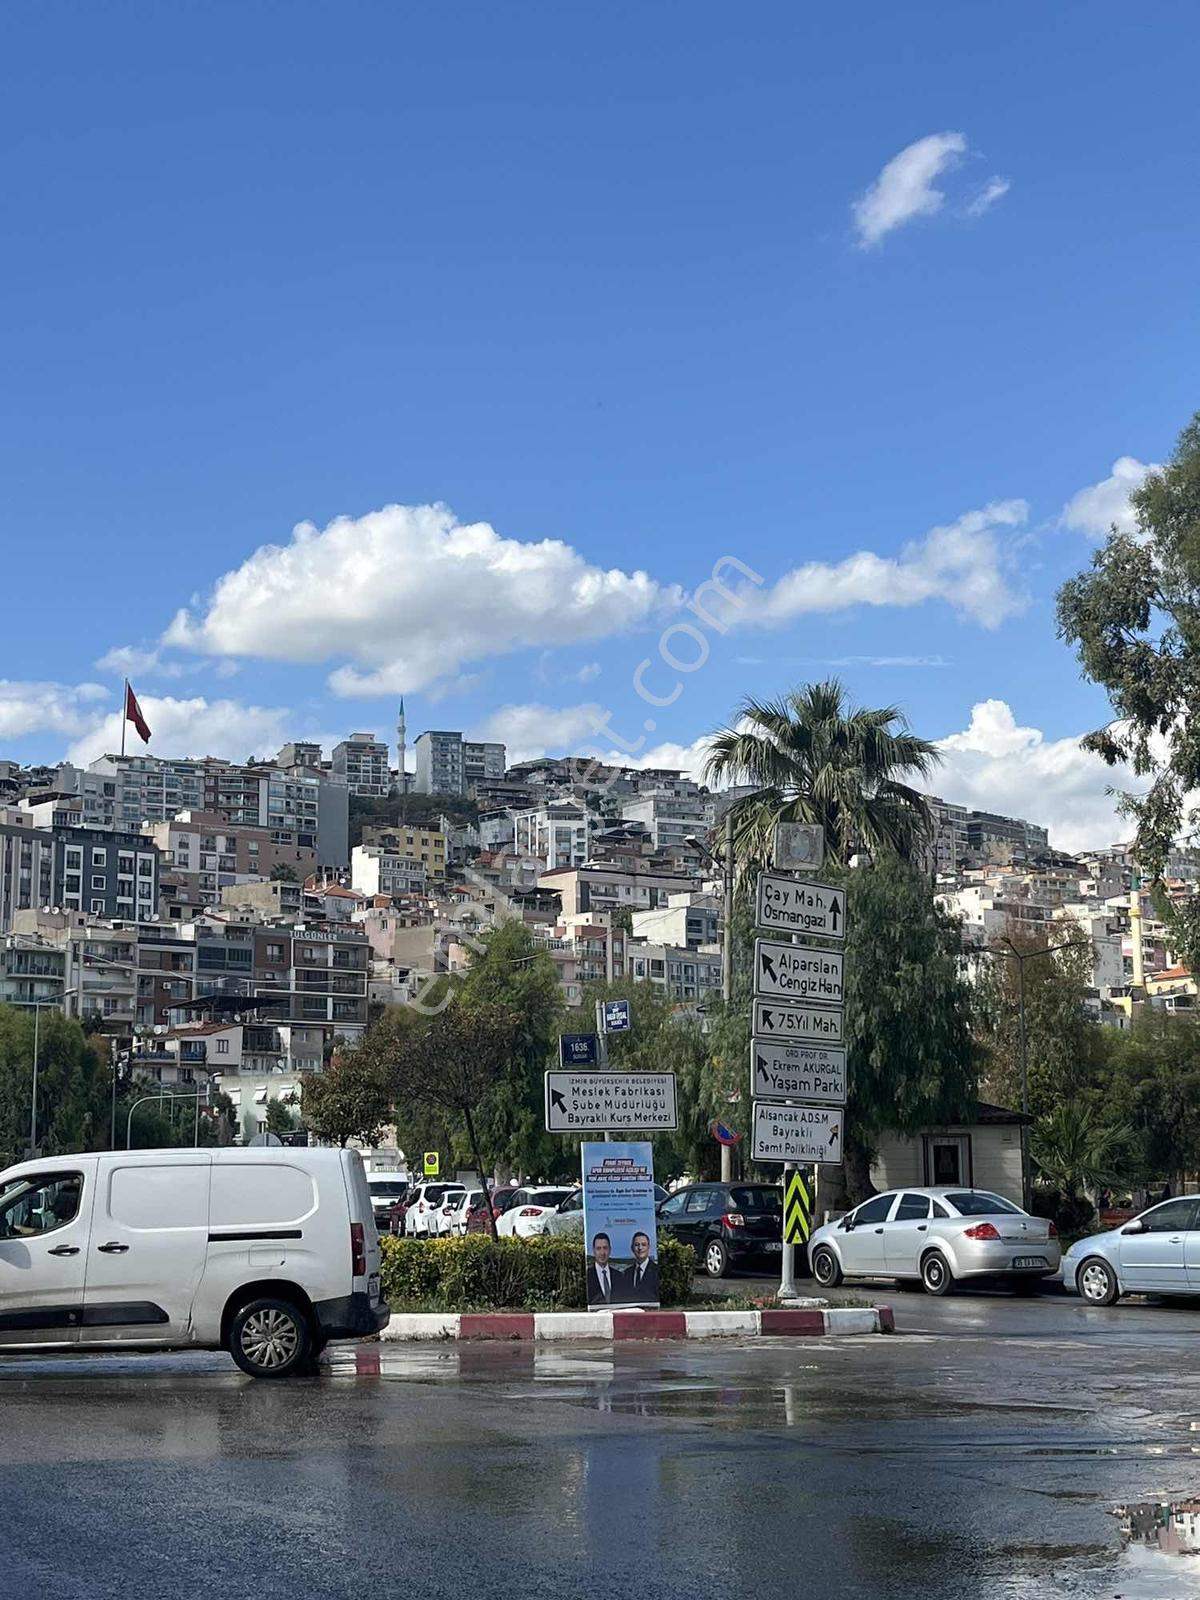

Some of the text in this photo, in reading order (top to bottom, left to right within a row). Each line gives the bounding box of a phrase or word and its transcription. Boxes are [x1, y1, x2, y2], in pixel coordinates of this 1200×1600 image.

[765, 884, 827, 909] Çay Mah.
[764, 904, 826, 928] Osmangazi
[779, 953, 839, 975] Alparslan
[780, 973, 841, 995] Cengiz Han
[813, 1016, 839, 1033] Mah.
[773, 1060, 842, 1075] Ekrem AKURGAL
[571, 1086, 665, 1097] Meslek Fabrikası
[770, 1074, 843, 1093] Yaşam Parkı
[572, 1099, 666, 1112] Şube Müdürlüğü
[567, 1111, 671, 1126] Bayraklı Kurs Merkezi
[759, 1109, 799, 1122] Alsancak
[772, 1125, 813, 1140] Bayraklı
[759, 1140, 827, 1158] Semt Polikliniği
